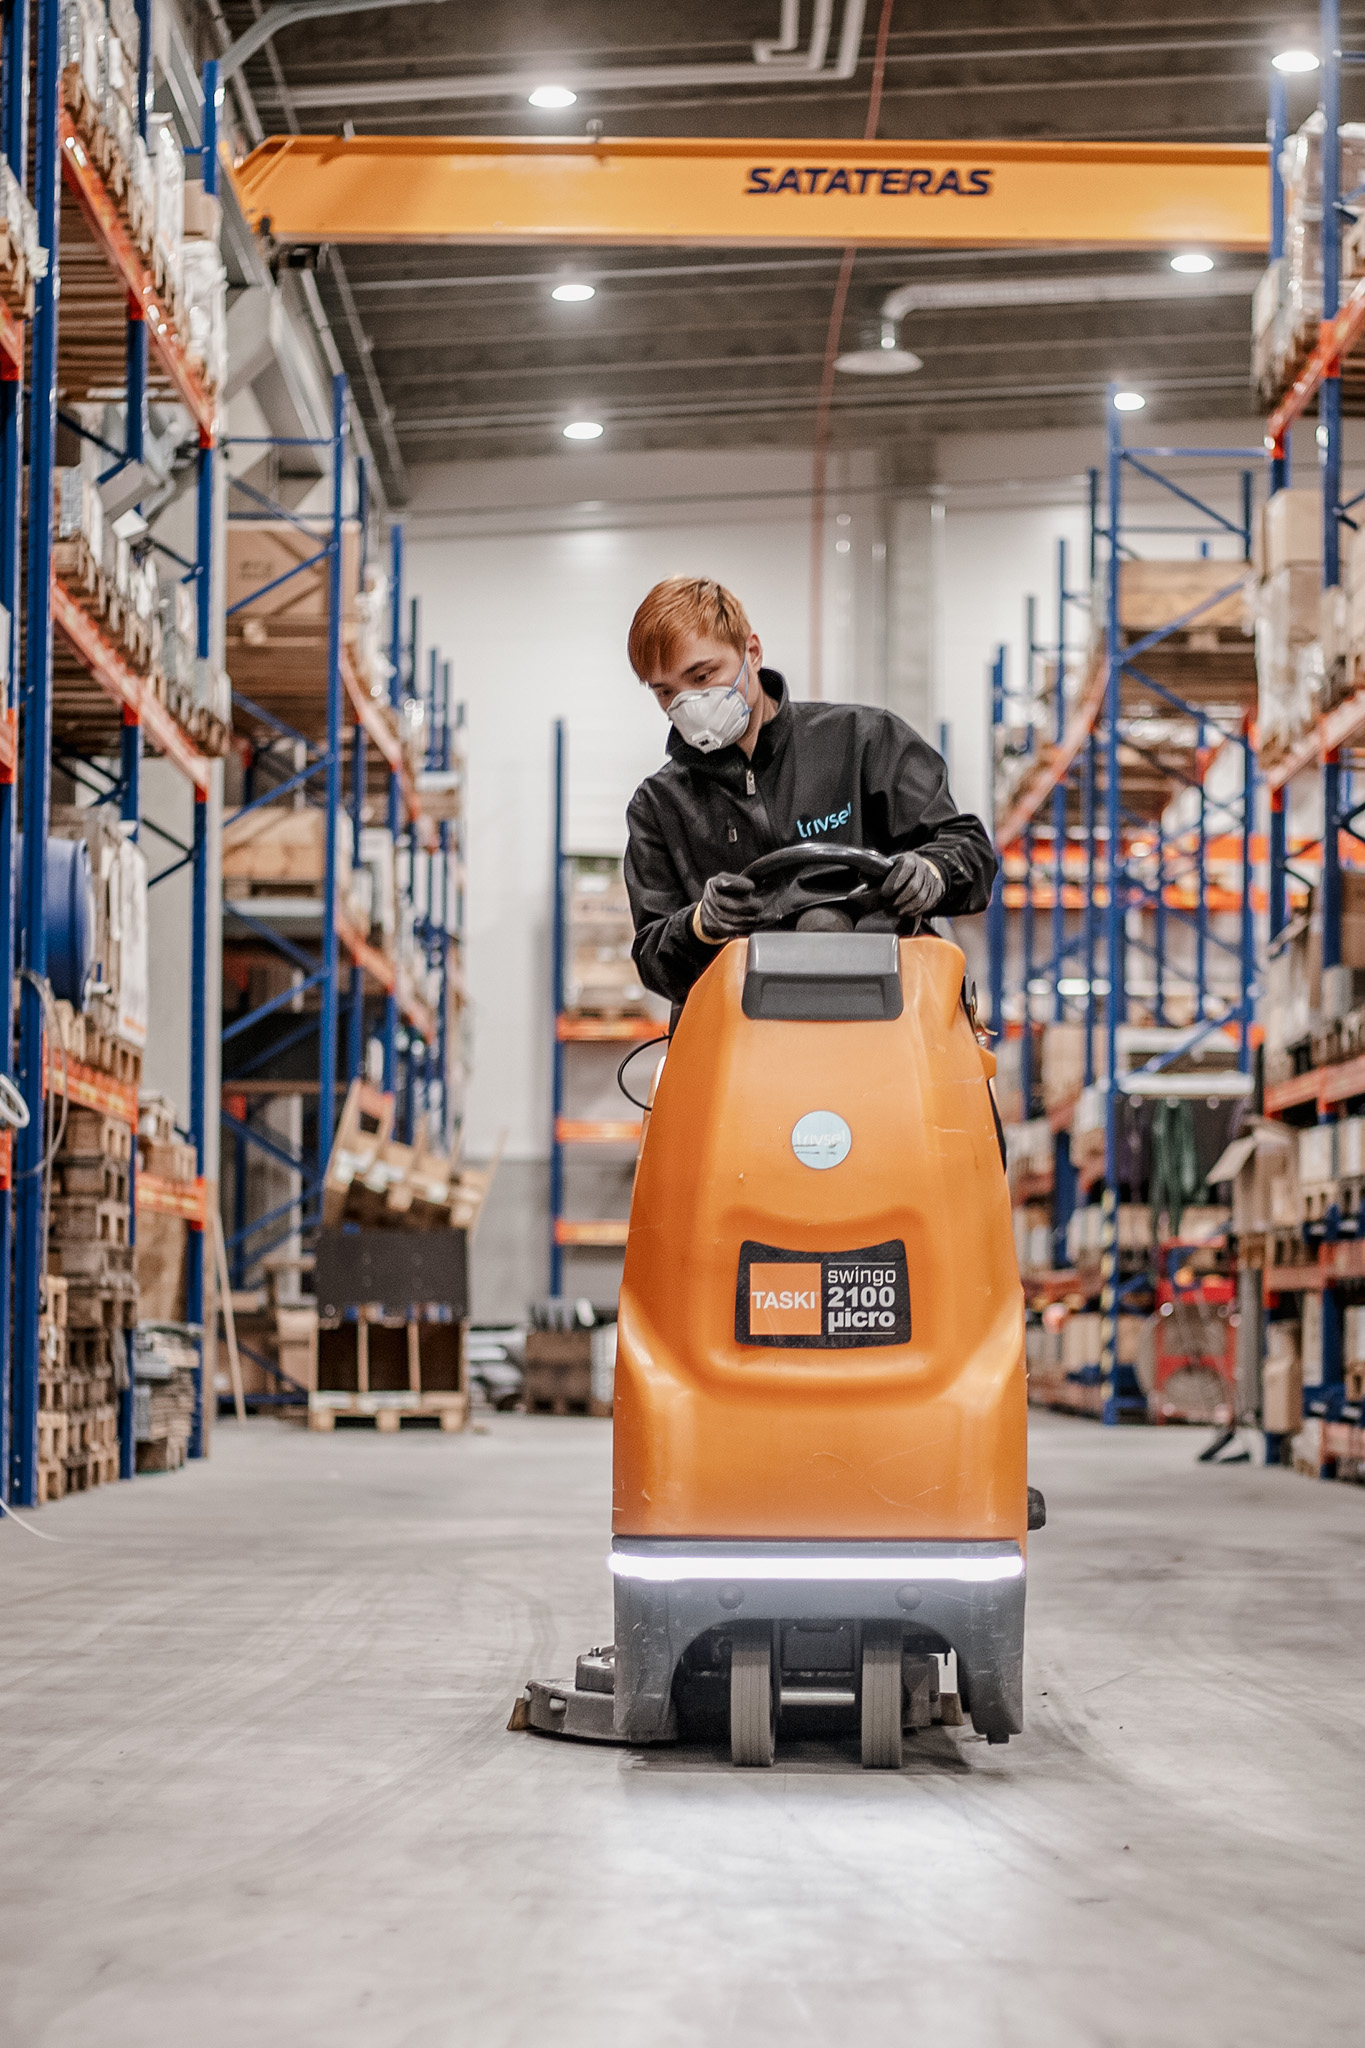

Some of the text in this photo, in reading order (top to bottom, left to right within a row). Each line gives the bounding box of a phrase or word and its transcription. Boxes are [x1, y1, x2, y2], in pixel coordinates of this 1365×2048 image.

[746, 168, 992, 195] SATATERAS
[796, 801, 852, 838] trivsel
[827, 1266, 896, 1286] swingo
[752, 1291, 816, 1309] TASKI
[827, 1286, 895, 1308] 2100
